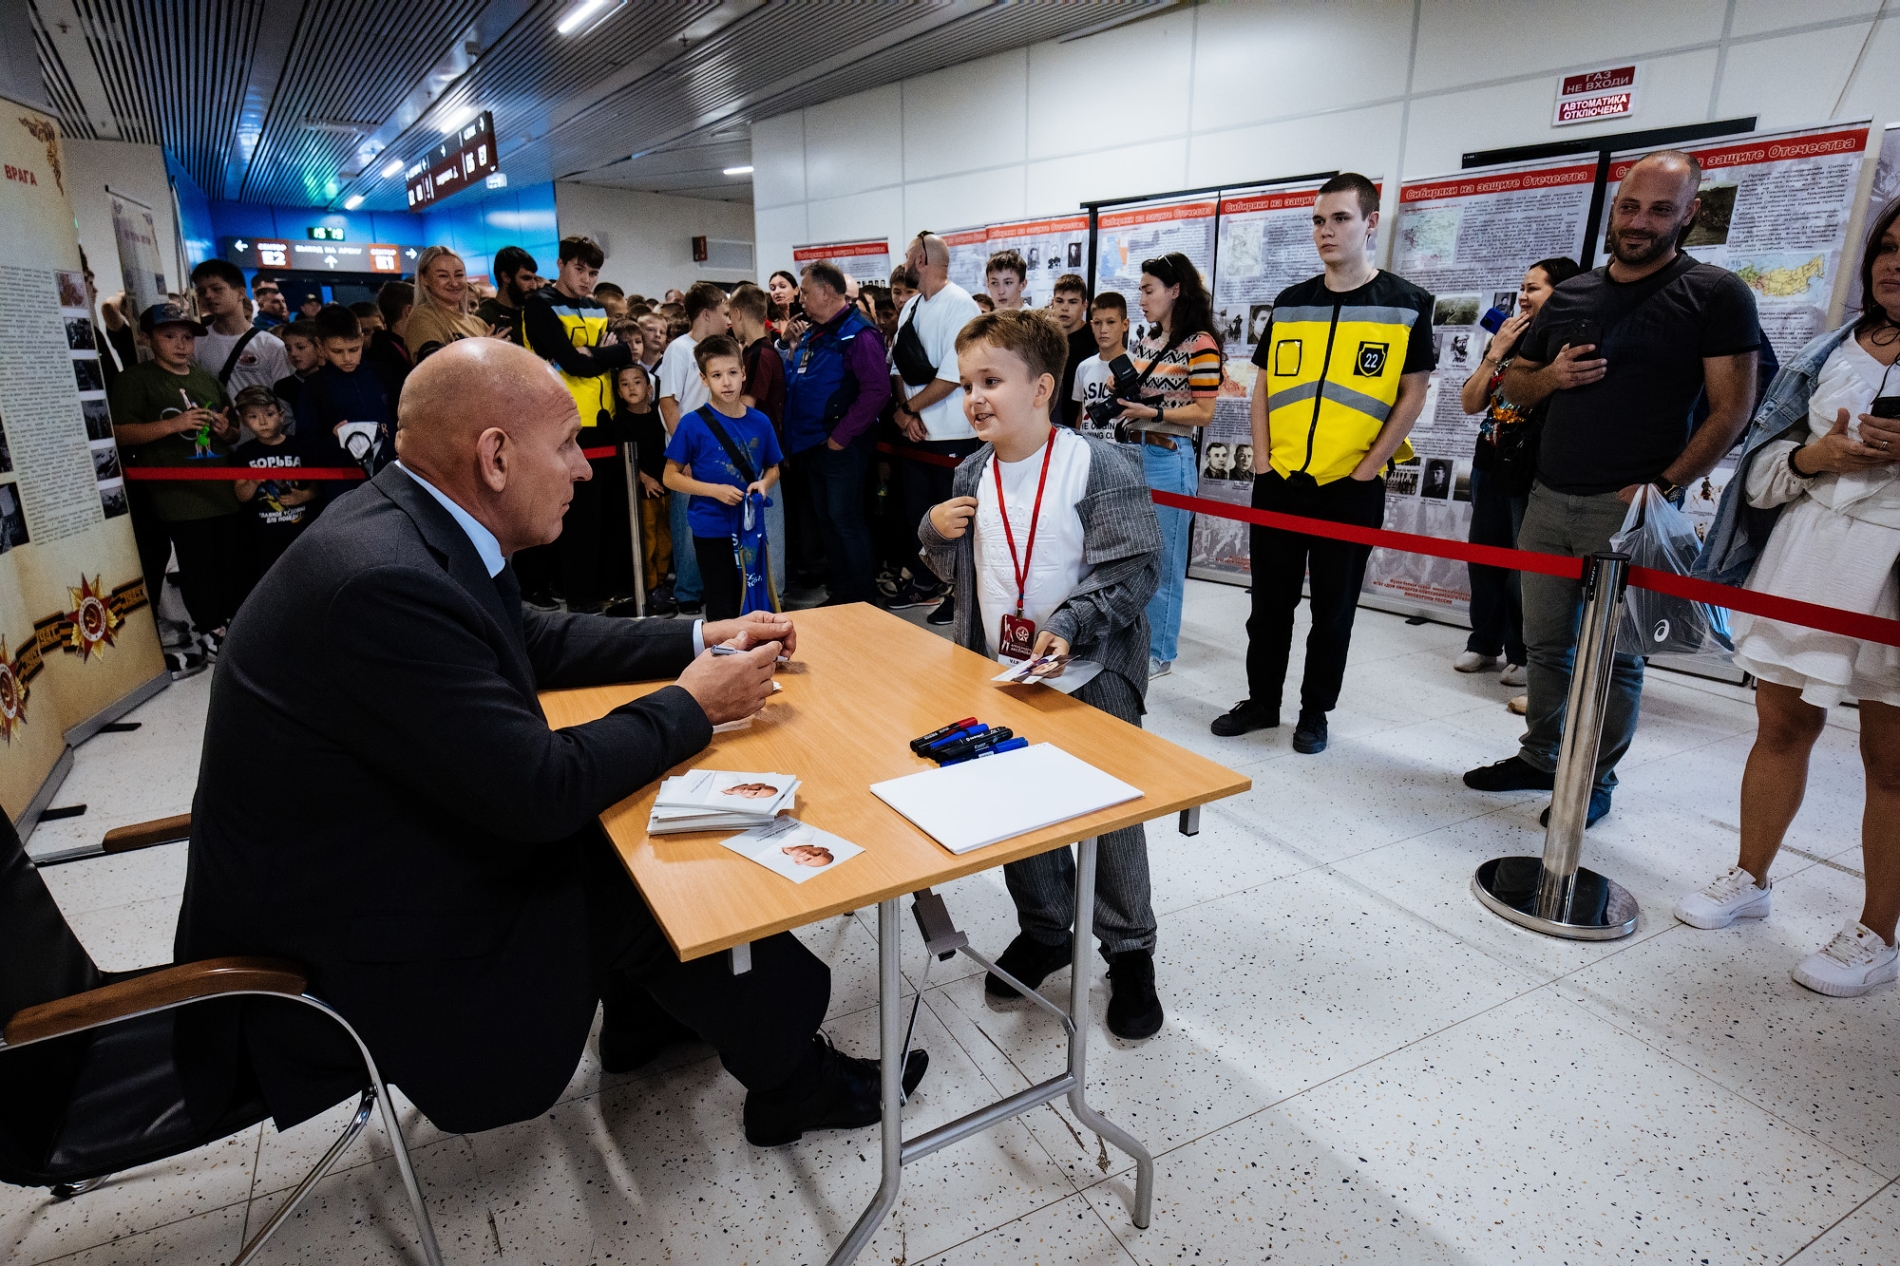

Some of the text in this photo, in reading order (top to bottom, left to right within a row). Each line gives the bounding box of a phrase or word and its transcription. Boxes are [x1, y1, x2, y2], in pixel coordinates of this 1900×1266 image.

[1585, 70, 1612, 81] ГАЗ
[1566, 76, 1630, 94] НЕ ВХОДИ
[1562, 94, 1627, 112] АВТОМАТИКА
[1563, 104, 1624, 120] ОТКЛЮЧЕНА
[1706, 149, 1765, 167] защите
[1768, 138, 1856, 159] Отечества
[4, 164, 38, 186] ВРАГА
[1405, 171, 1588, 200] Сибиряки на защите Отечества
[1224, 194, 1318, 213] Сибиряки на защит
[1363, 352, 1379, 369] 22
[249, 455, 301, 469] БОРЬБА
